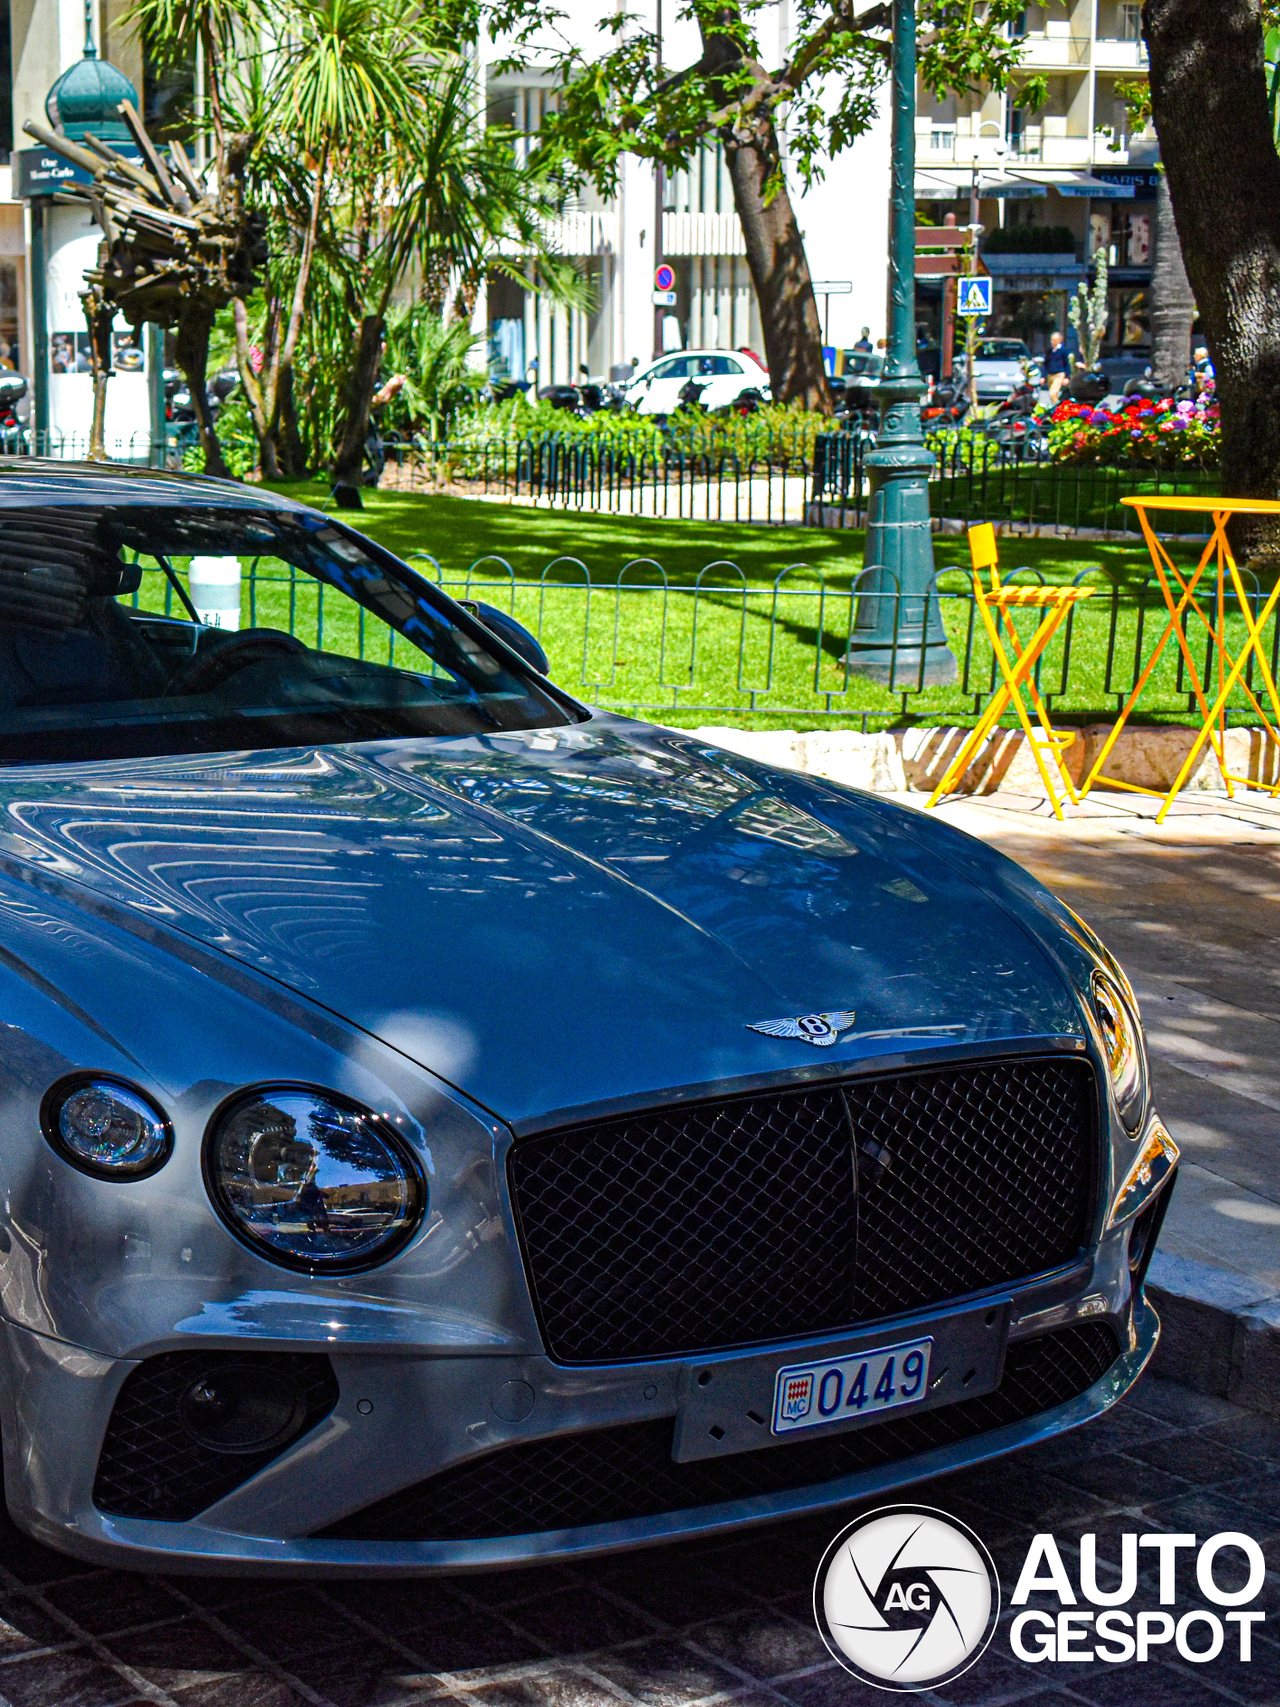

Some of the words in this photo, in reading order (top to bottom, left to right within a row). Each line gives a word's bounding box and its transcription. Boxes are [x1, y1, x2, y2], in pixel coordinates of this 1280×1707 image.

[41, 158, 58, 168] One
[1101, 175, 1144, 186] PARIS
[818, 1350, 924, 1416] 0449
[787, 1399, 806, 1415] MC
